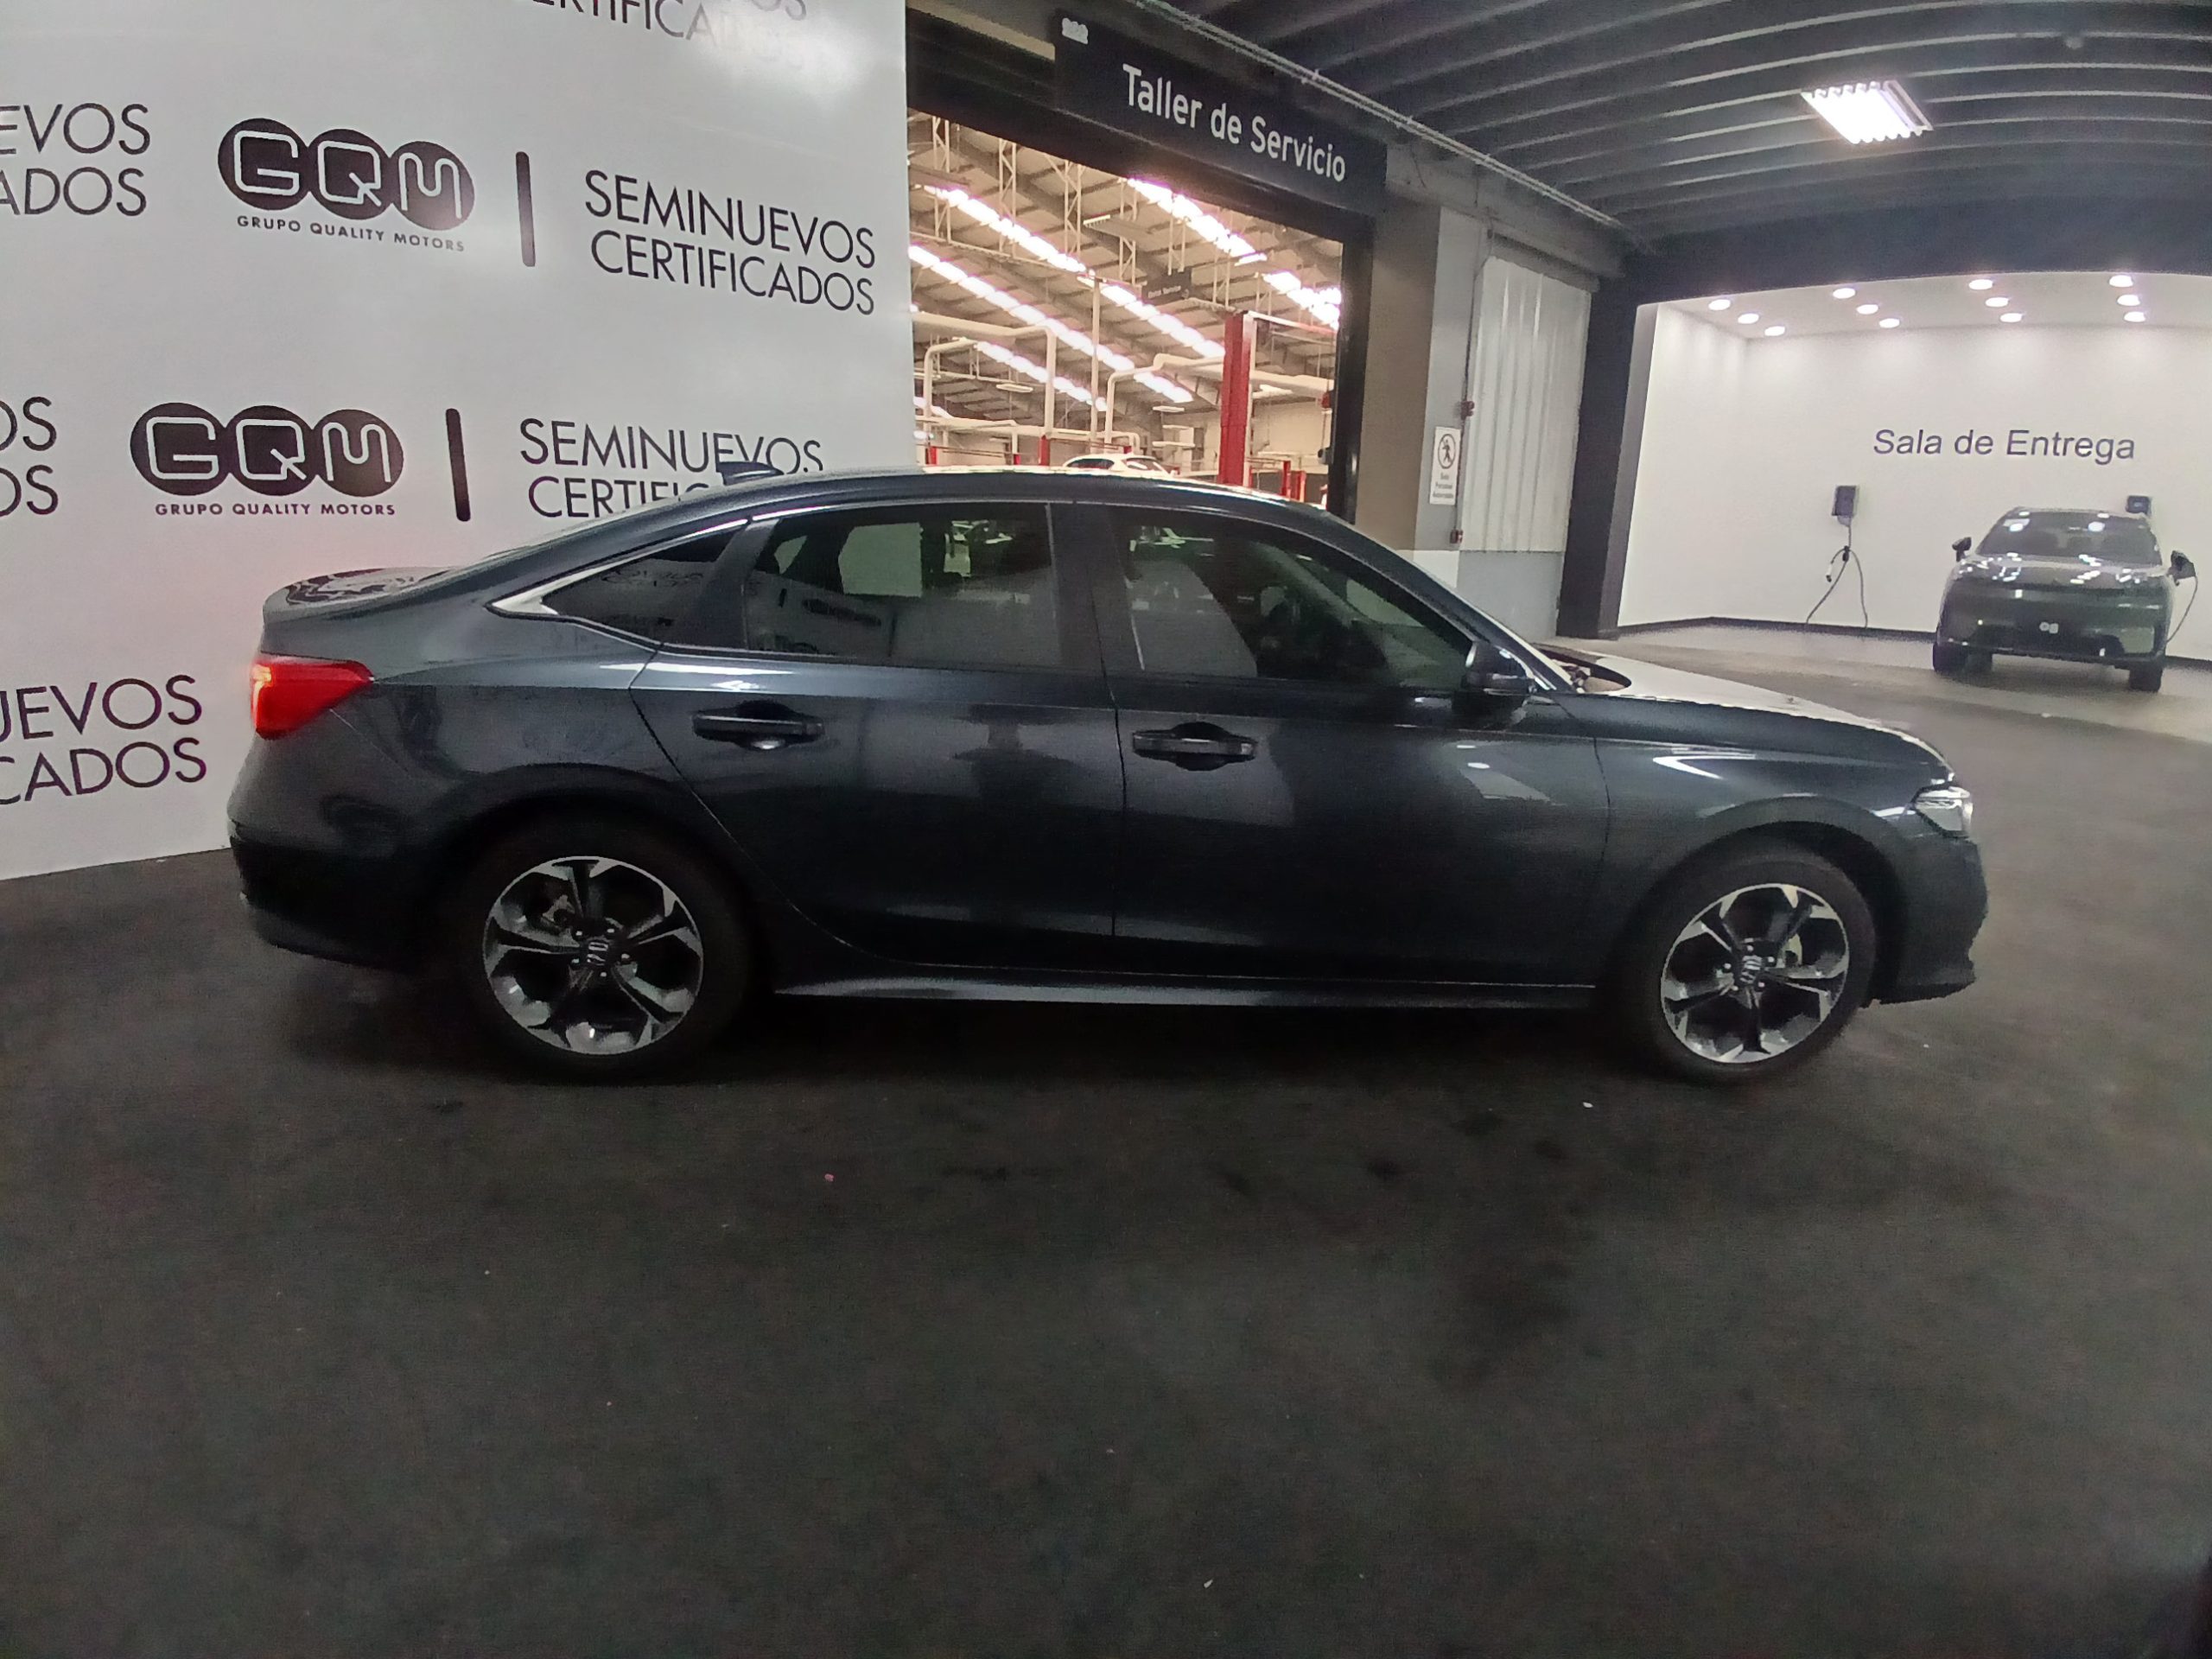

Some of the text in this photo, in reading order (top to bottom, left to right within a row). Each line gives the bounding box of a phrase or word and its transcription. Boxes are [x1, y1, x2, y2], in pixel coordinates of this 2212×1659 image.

[1122, 63, 1346, 182] Taller de Servicio
[232, 129, 463, 219] GQM
[237, 215, 466, 252] GRUPO QUALITY MOTORS
[584, 169, 875, 269] SEMINUEVOS
[590, 230, 875, 315] CERTIFICADOS
[144, 415, 394, 484] GQM
[519, 417, 823, 477] SEMINUEVOS
[1872, 429, 2135, 466] Sala de Entrega
[155, 502, 396, 516] GRUPO QUALITY MOTORS
